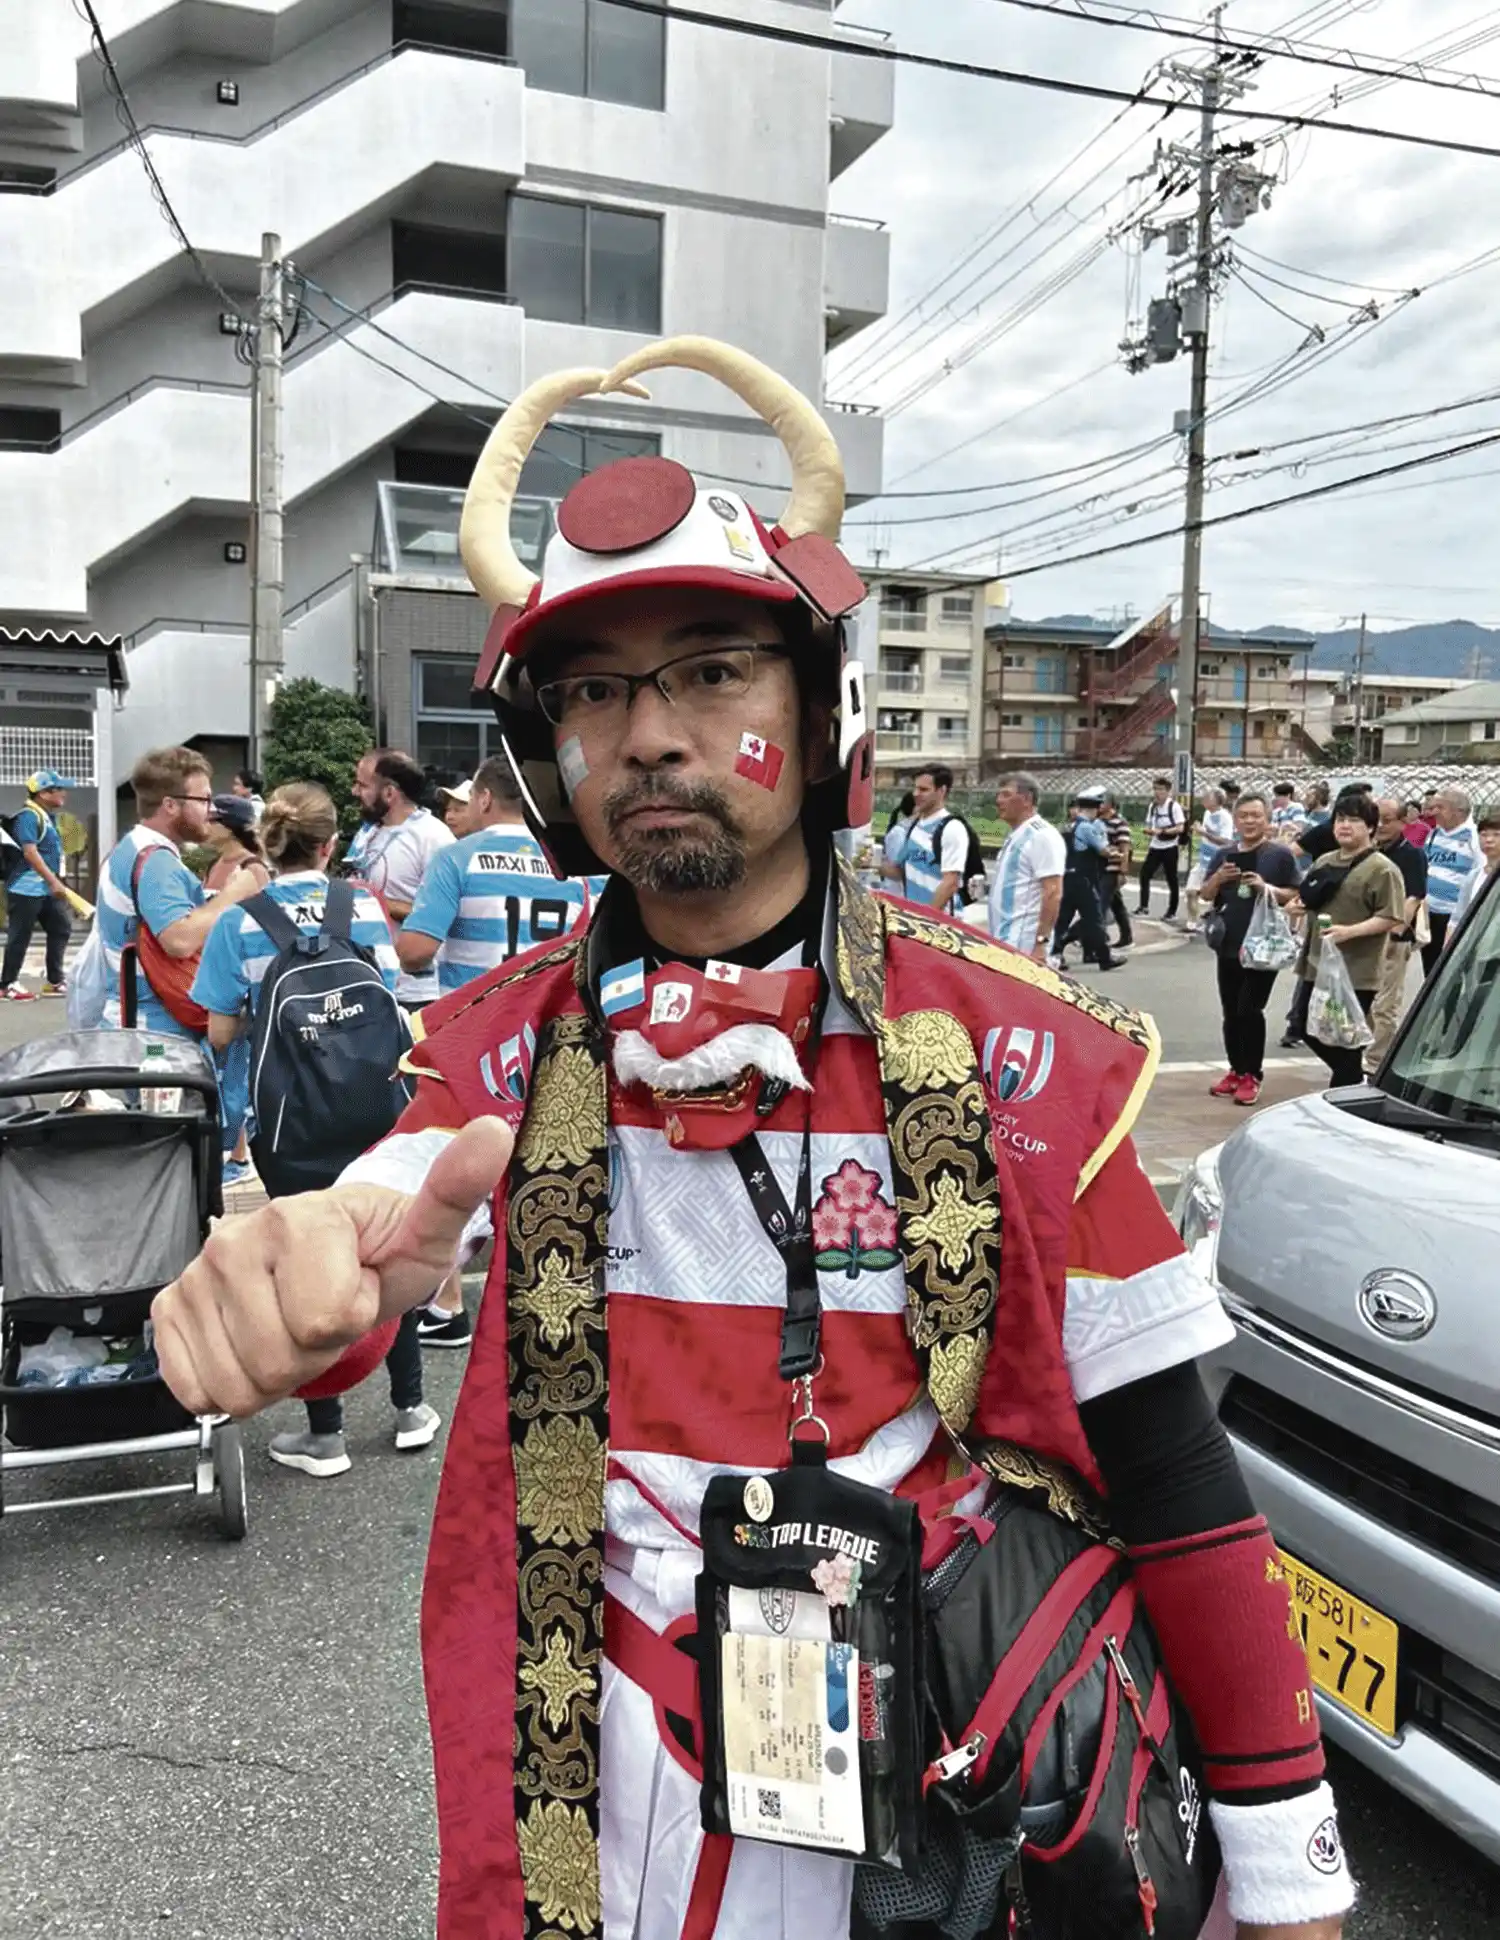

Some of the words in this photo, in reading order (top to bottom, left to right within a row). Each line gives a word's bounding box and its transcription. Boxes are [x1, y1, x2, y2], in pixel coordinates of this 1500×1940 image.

[478, 853, 526, 873] MAXI
[770, 1522, 802, 1549] TOP
[802, 1522, 881, 1565] LEAGUE
